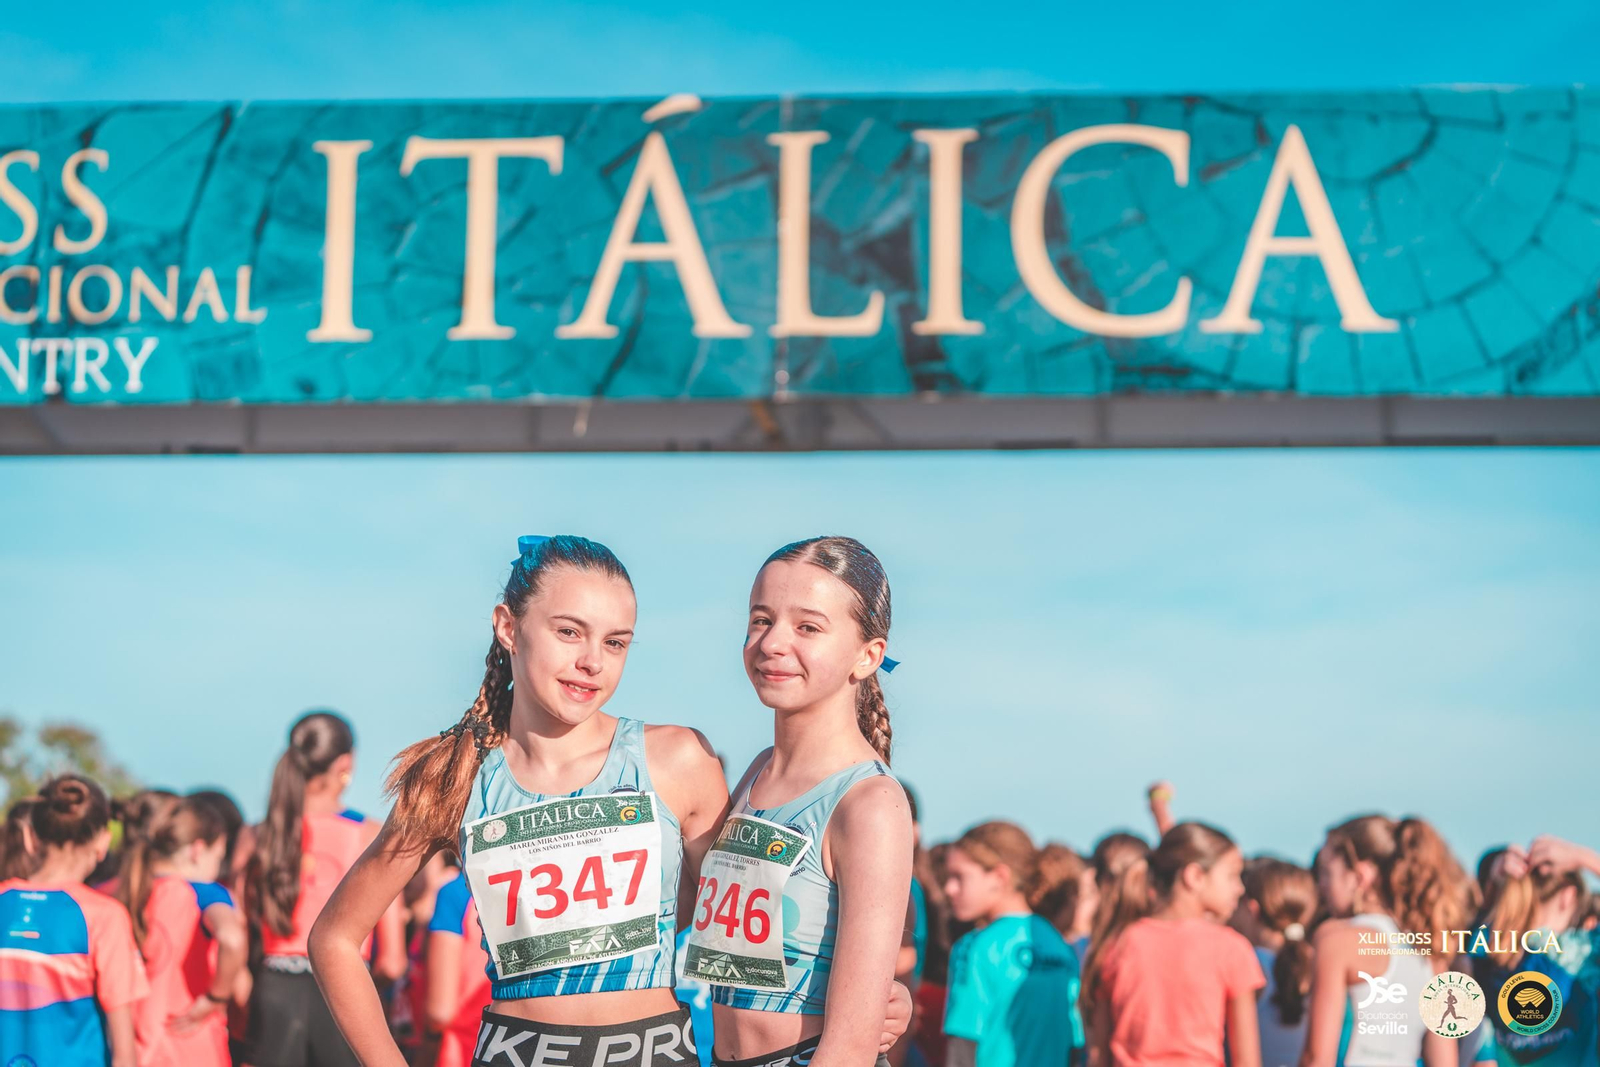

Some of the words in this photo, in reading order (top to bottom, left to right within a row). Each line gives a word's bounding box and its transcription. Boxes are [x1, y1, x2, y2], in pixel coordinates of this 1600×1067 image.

[306, 94, 1399, 343] ITÁLICA
[520, 803, 607, 830] ITÁLICA
[537, 835, 574, 846] MIRANDA
[488, 849, 648, 926] 7347
